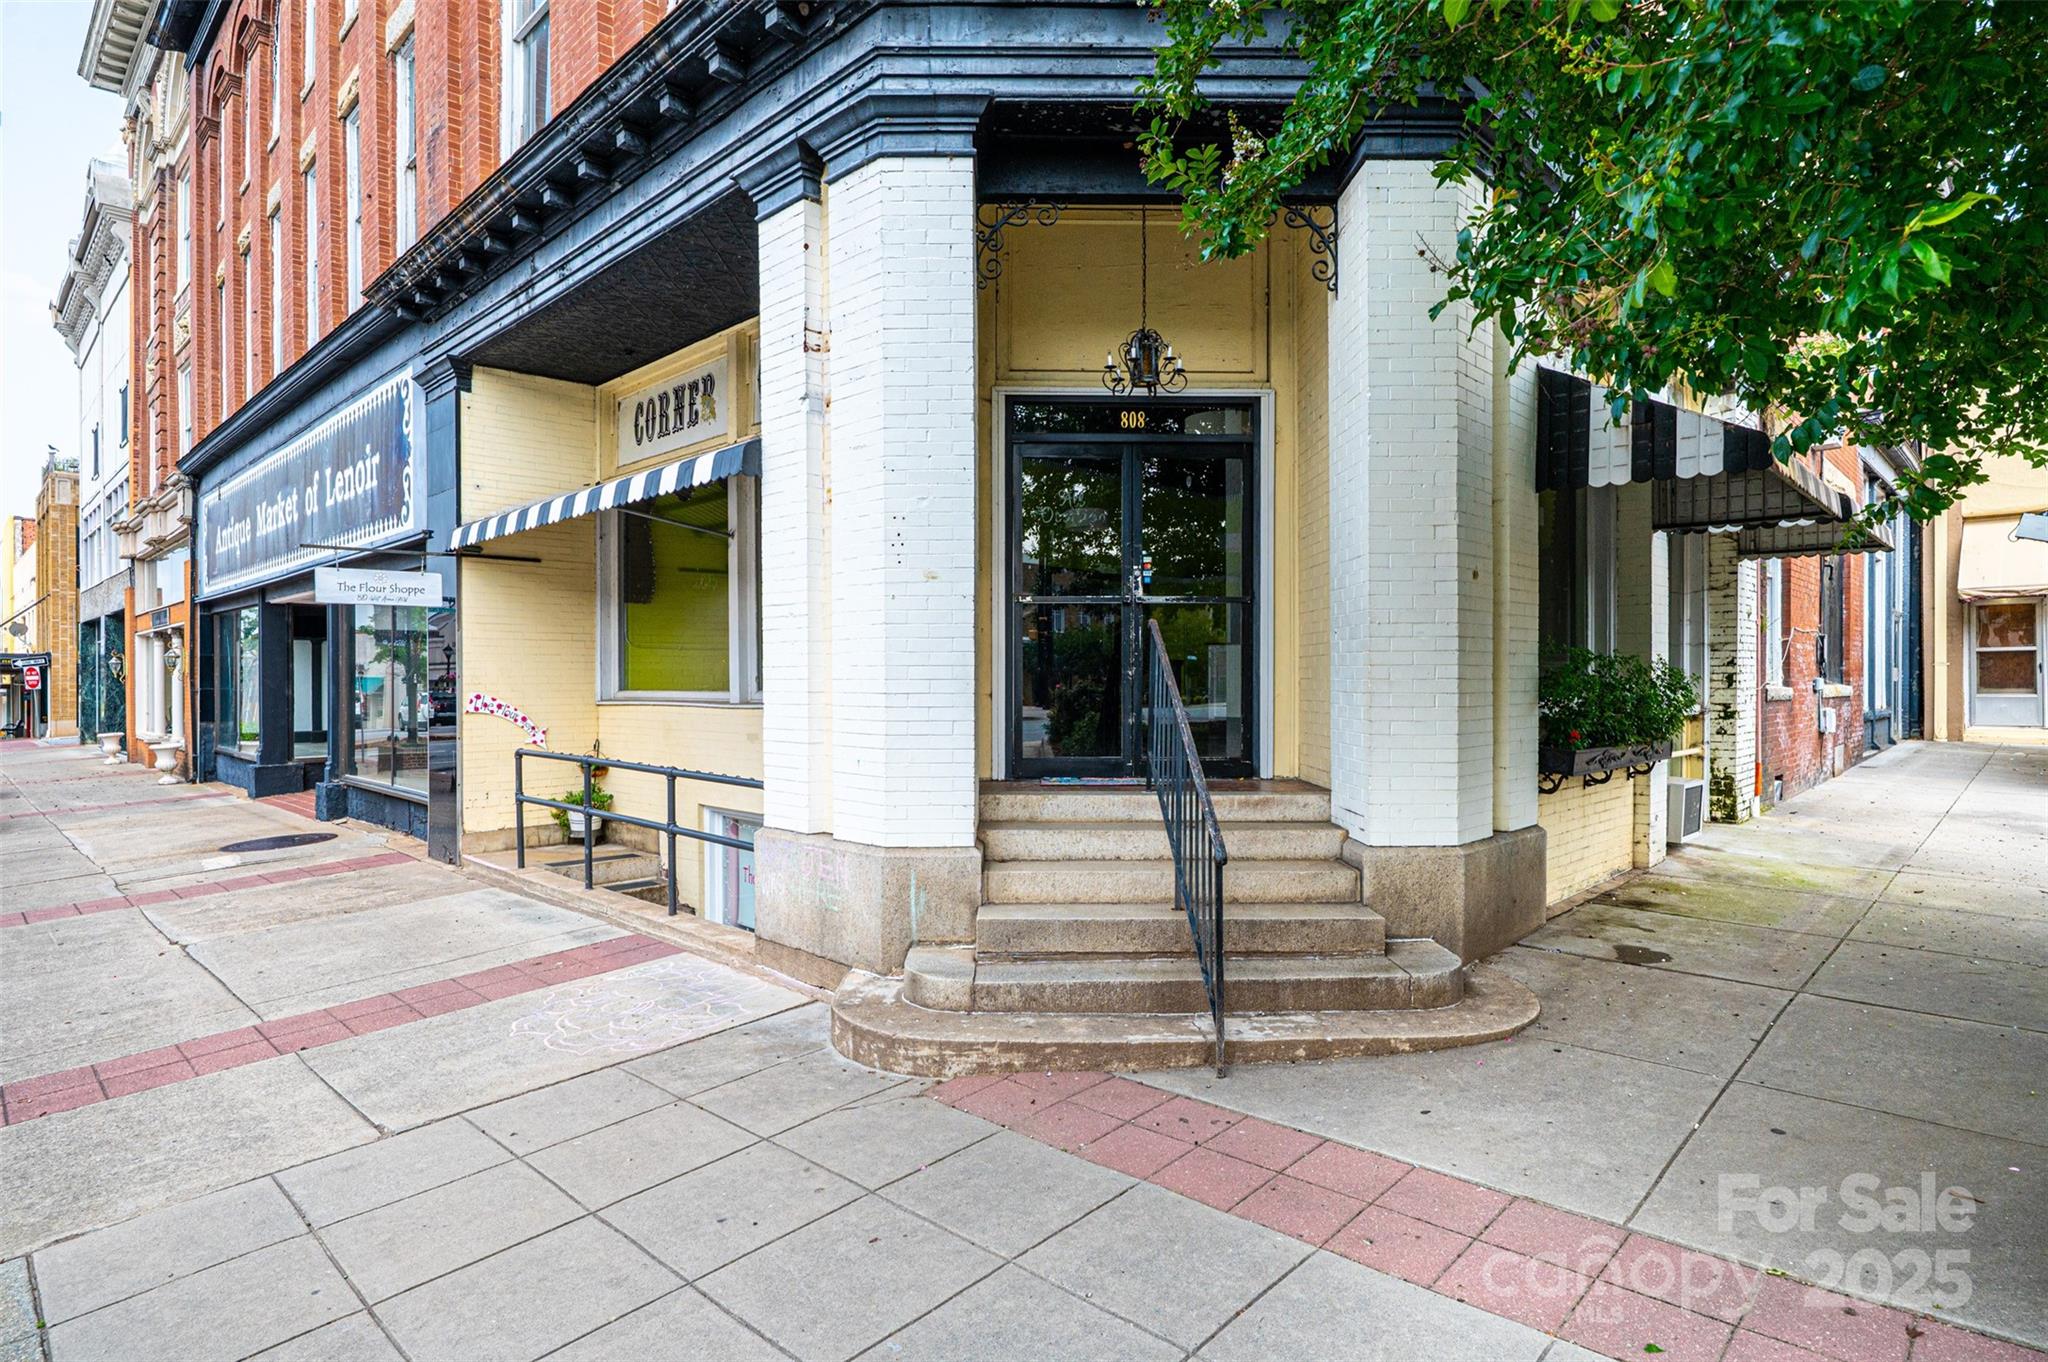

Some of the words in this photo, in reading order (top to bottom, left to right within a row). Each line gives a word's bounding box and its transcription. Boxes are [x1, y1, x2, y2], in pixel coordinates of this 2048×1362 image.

[634, 372, 717, 446] CORNER
[1120, 411, 1146, 428] 808
[215, 516, 252, 558] Antique
[255, 491, 299, 537] Market
[304, 470, 320, 517] of
[325, 443, 381, 508] Lenoir
[337, 581, 356, 593] The
[359, 581, 387, 594] Flour
[389, 583, 426, 597] Shoppe
